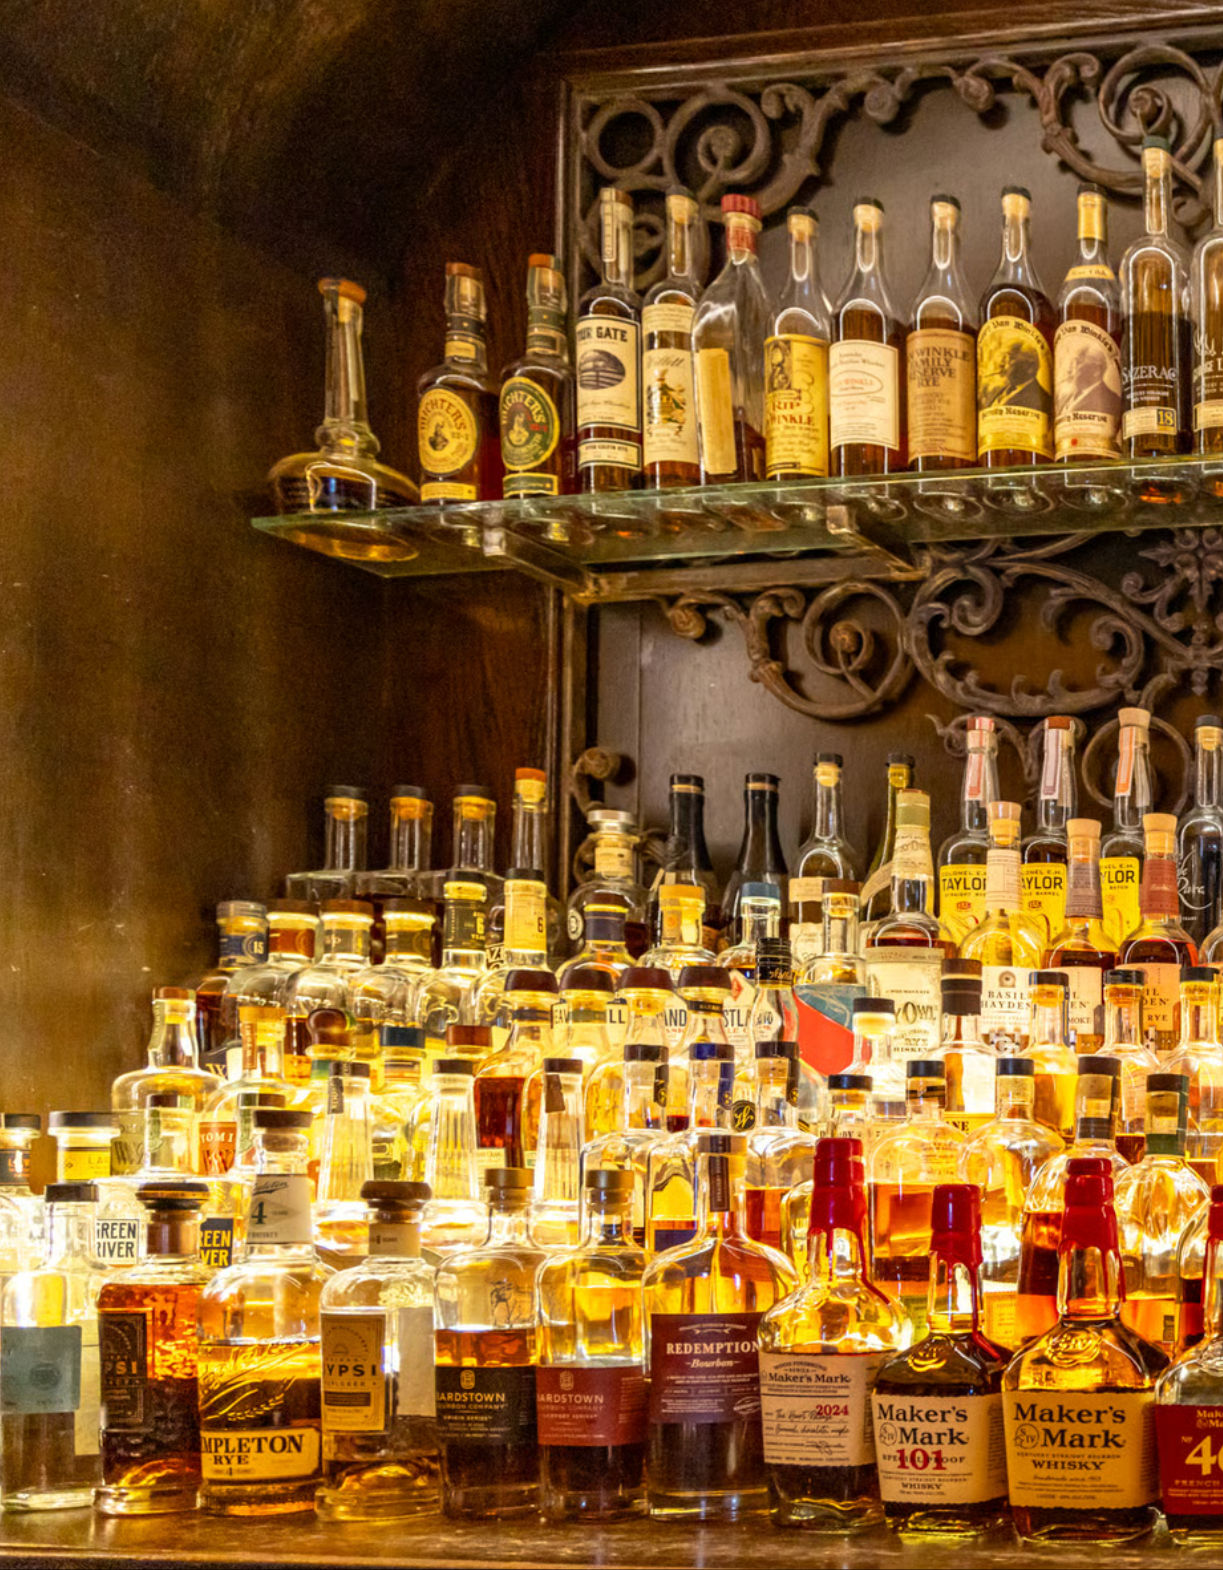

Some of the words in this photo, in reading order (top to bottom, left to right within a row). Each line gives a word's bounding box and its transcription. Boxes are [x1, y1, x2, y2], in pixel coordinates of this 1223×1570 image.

[596, 326, 628, 343] GATE
[1121, 365, 1177, 385] SAZERAC
[917, 376, 941, 389] RYE
[772, 402, 800, 411] RIP
[1005, 407, 1041, 420] Reserve
[1072, 412, 1108, 423] Reserve
[1158, 410, 1175, 427] 18
[1021, 876, 1063, 891] AYLOR
[537, 917, 544, 933] 6
[253, 942, 264, 955] 15
[904, 1001, 936, 1024] OWL
[1148, 1014, 1168, 1022] RYE
[252, 1201, 267, 1225] 4
[201, 1252, 229, 1267] VER
[666, 1341, 760, 1354] REDEMPTION
[690, 1359, 735, 1369] Bourbon
[326, 1365, 378, 1378] YPSI
[768, 1372, 812, 1383] Maker's
[814, 1374, 850, 1384] Mark
[816, 1404, 848, 1416] 2024
[877, 1402, 969, 1423] Maker's
[1013, 1402, 1126, 1424] Maker's
[898, 1427, 969, 1445] Mark
[1040, 1428, 1125, 1448] Mark
[201, 1434, 304, 1454] MPLETON
[213, 1455, 250, 1464] RYE
[896, 1448, 947, 1471] 101
[1032, 1459, 1106, 1471] WHISKY
[901, 1482, 942, 1490] WHISKY
[1174, 1479, 1220, 1487] FRENCH
